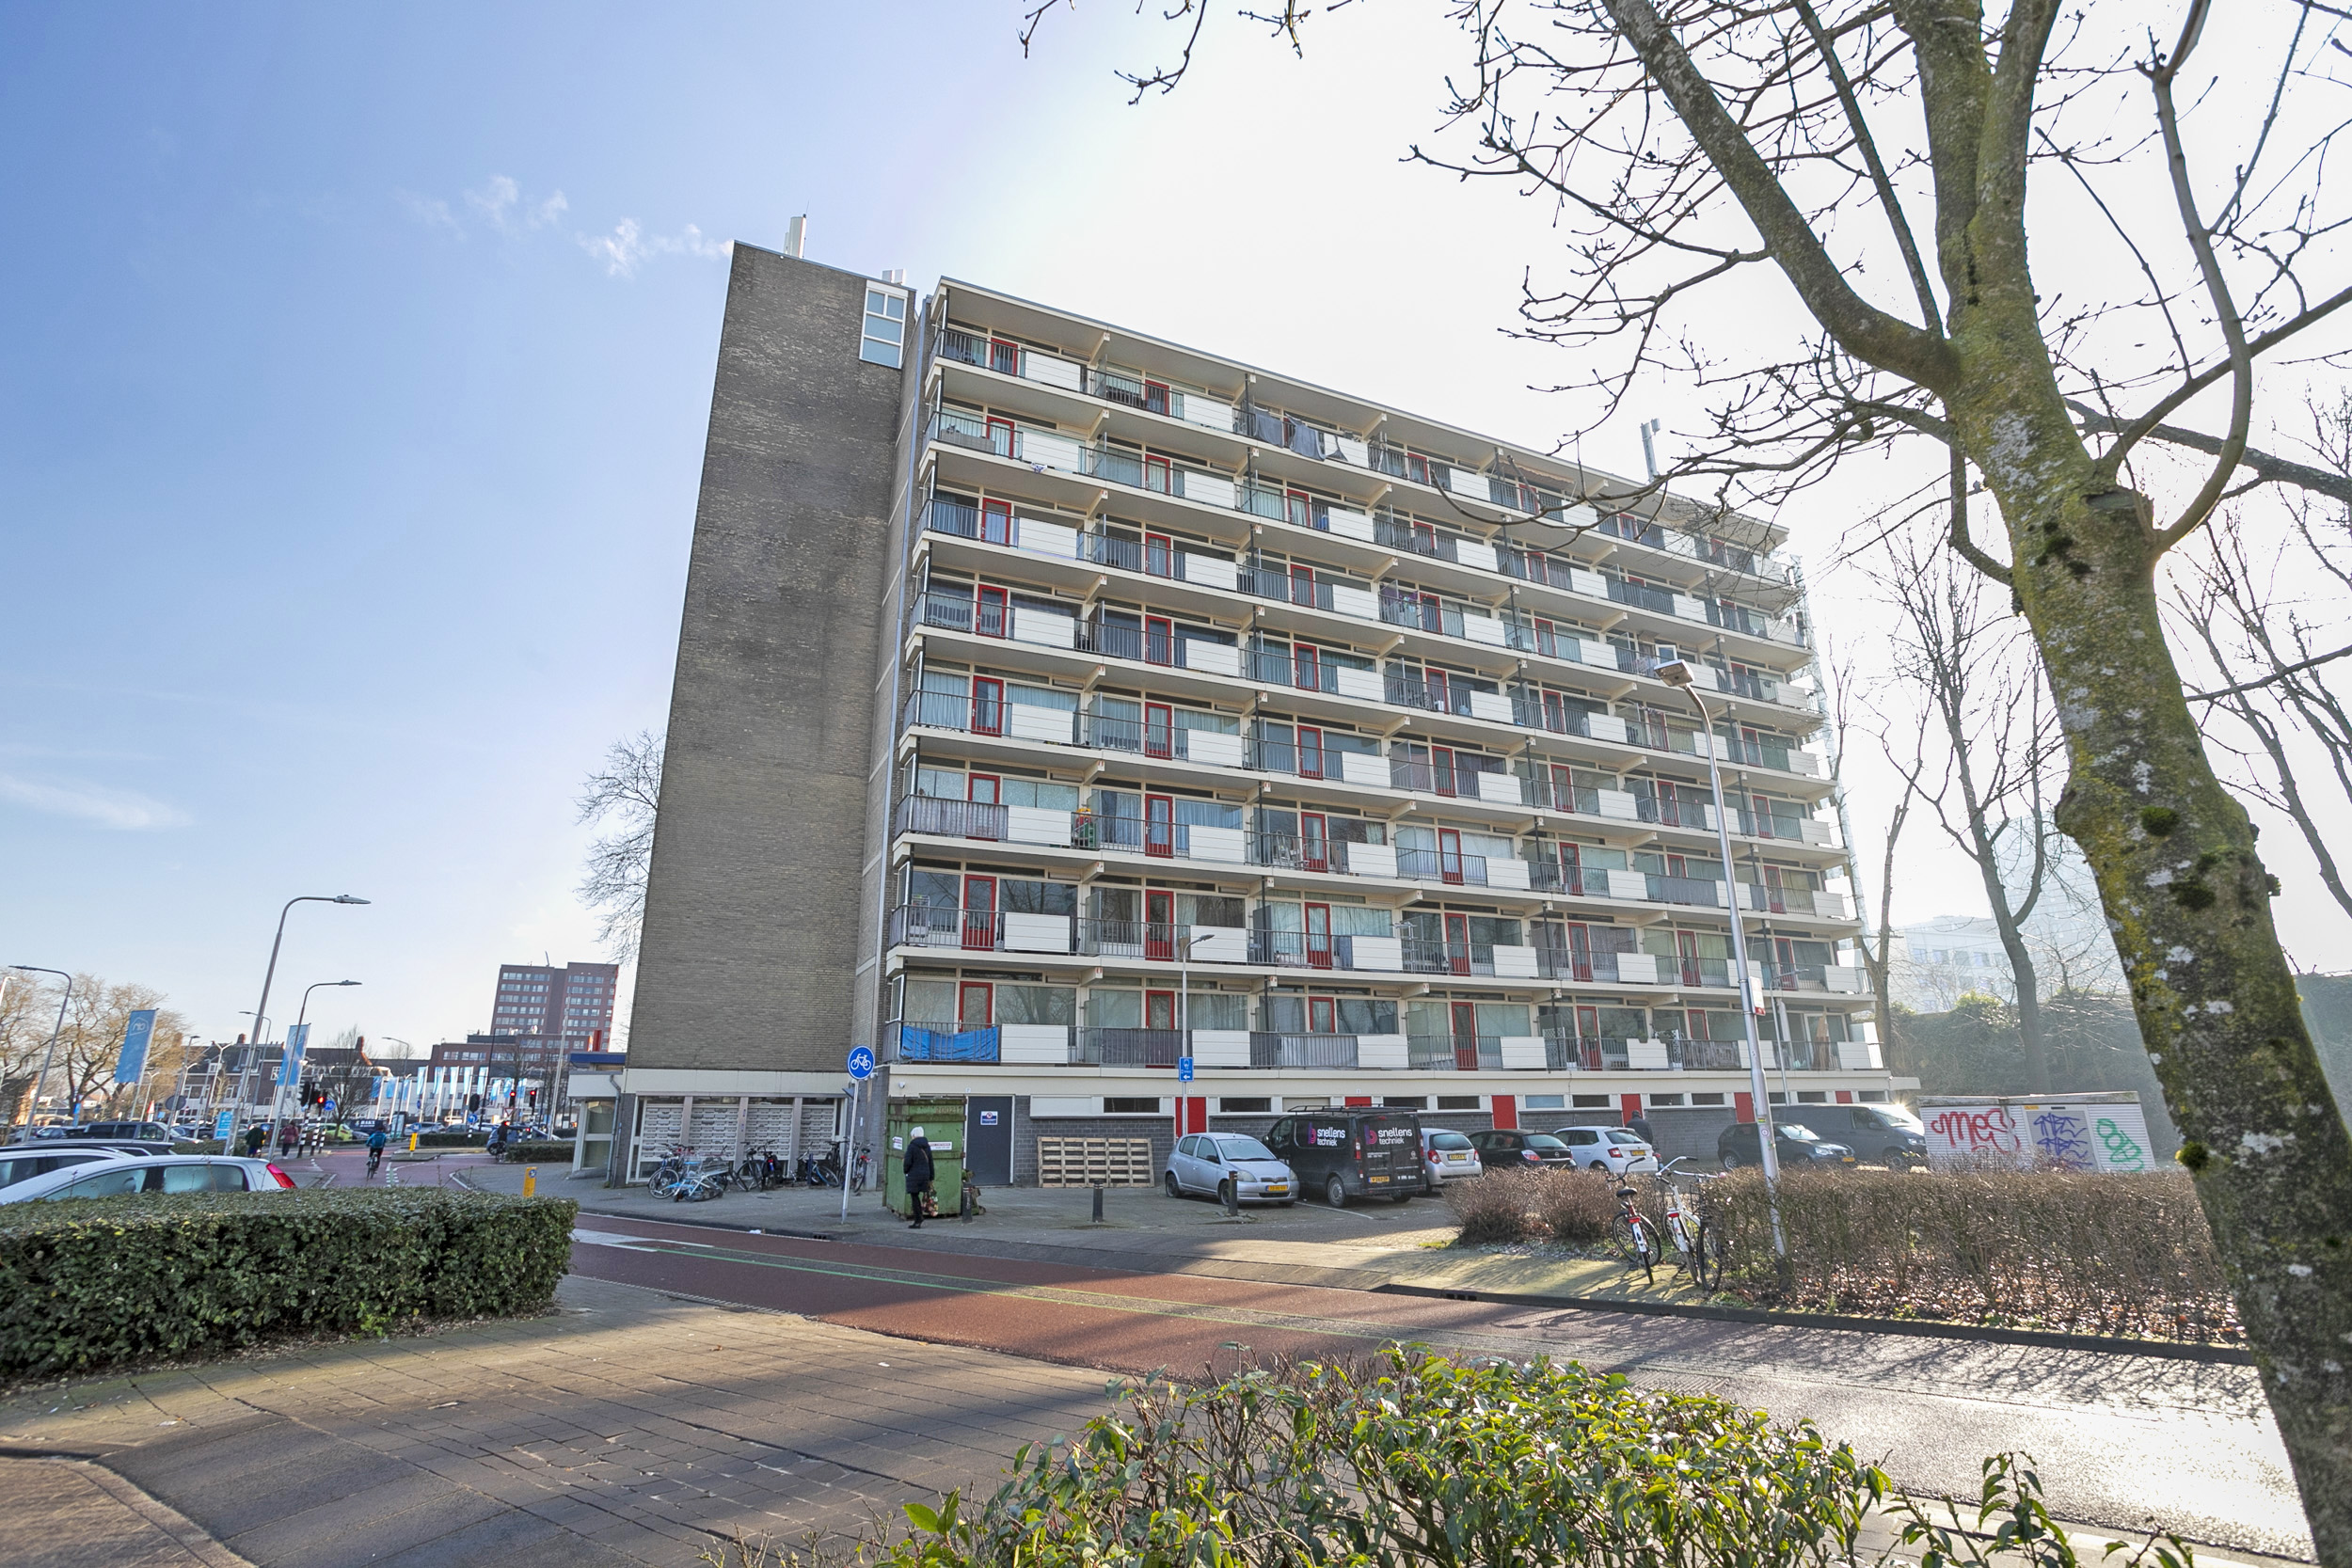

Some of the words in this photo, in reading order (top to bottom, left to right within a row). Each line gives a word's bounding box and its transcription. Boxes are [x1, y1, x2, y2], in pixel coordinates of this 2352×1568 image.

[1317, 1127, 1345, 1139] snellens
[1377, 1127, 1413, 1137] snellens
[1317, 1137, 1338, 1147] techniek
[1378, 1136, 1405, 1146] techniek
